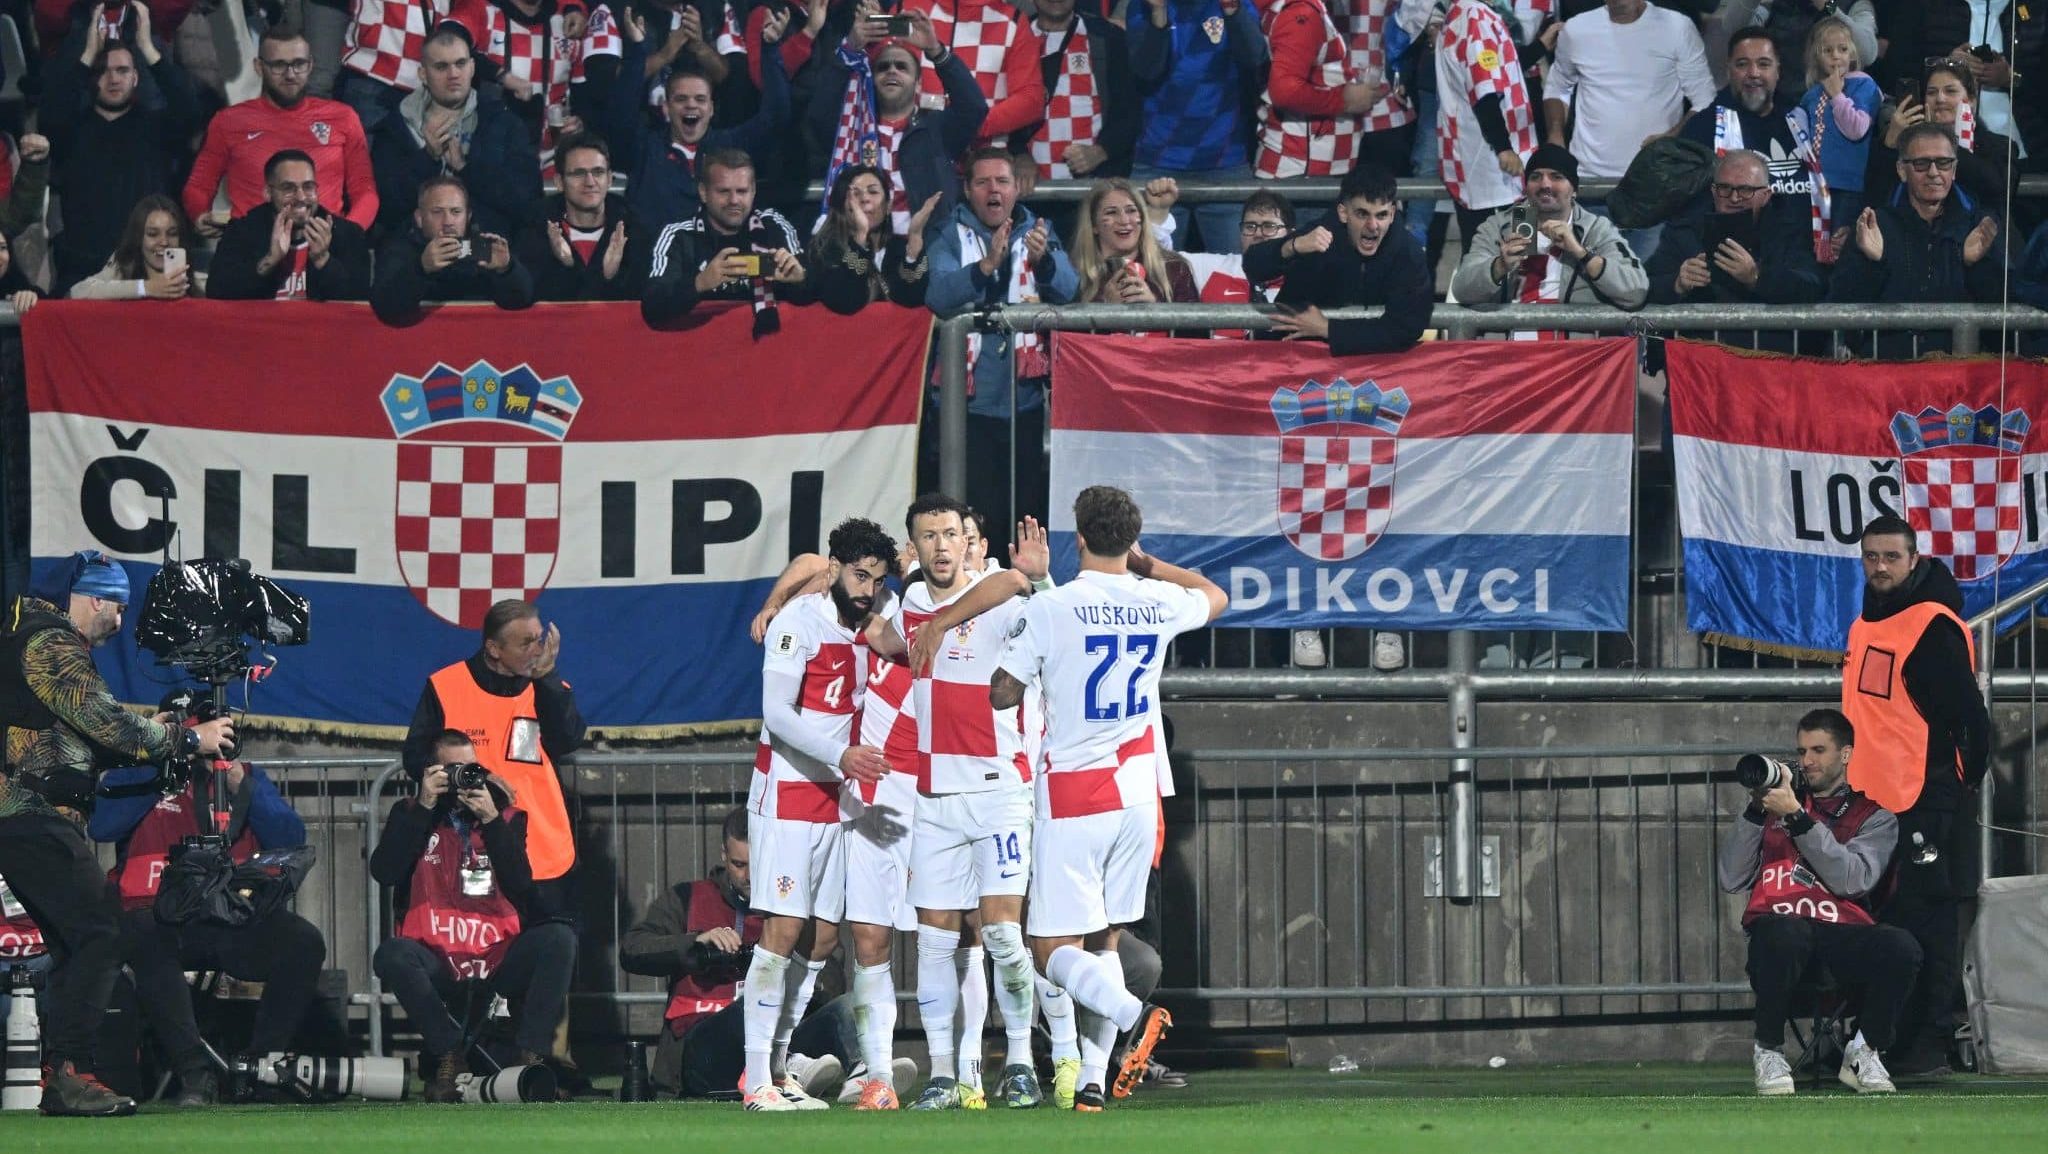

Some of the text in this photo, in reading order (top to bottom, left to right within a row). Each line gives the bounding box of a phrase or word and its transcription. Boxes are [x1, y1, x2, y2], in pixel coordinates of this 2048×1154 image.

[1769, 180, 1813, 194] didas
[1187, 566, 1550, 613] DIKOVCI
[823, 674, 846, 709] 4
[1085, 633, 1160, 722] 22
[472, 738, 490, 747] RITY
[993, 831, 1022, 866] 14
